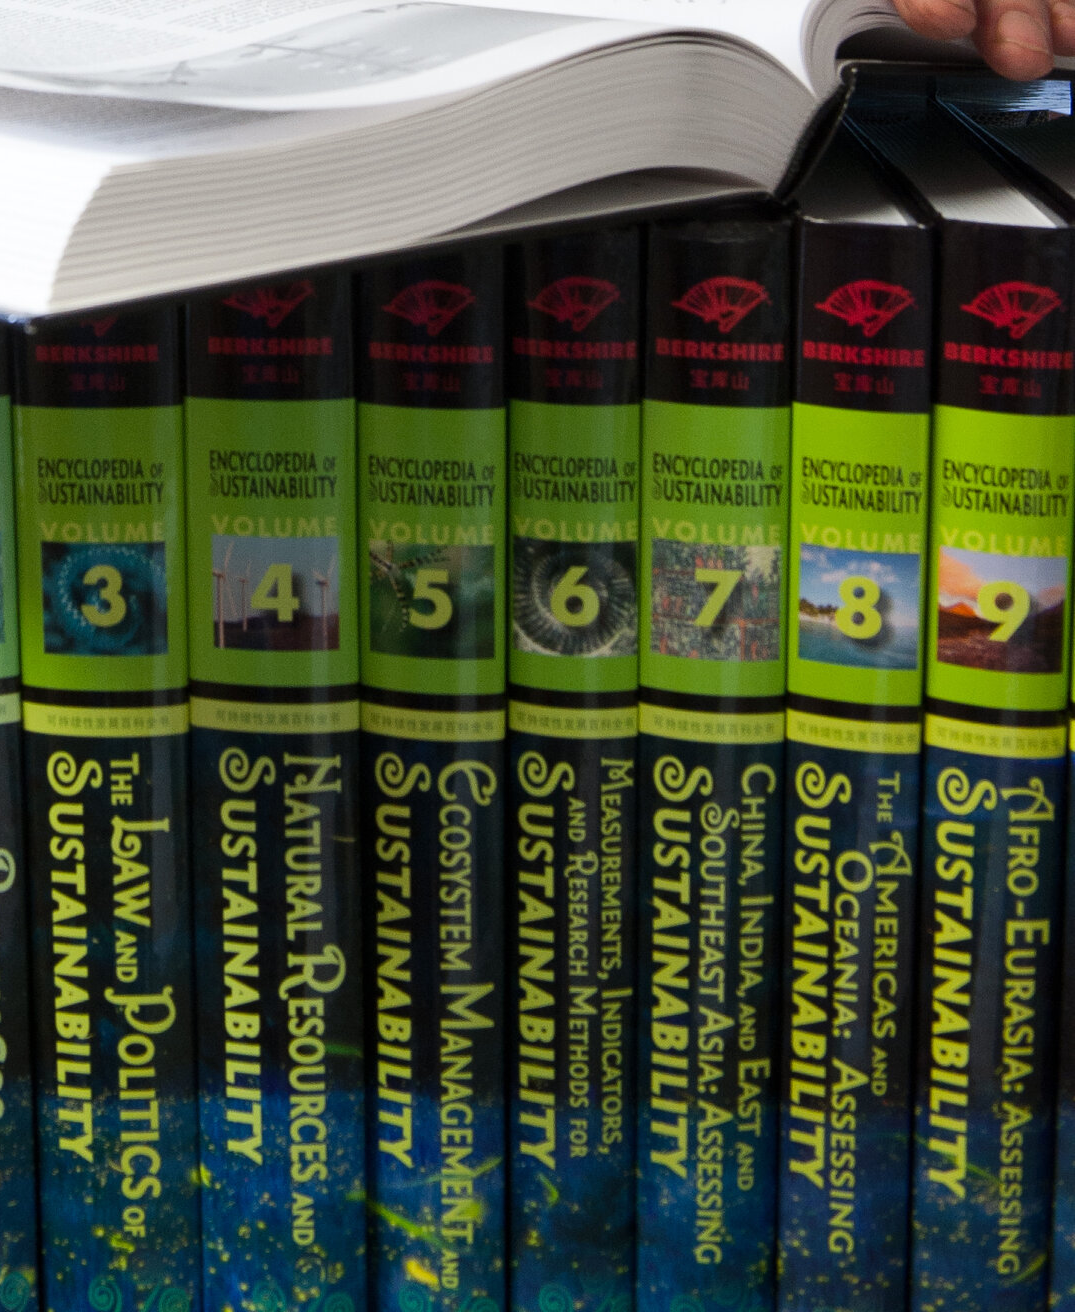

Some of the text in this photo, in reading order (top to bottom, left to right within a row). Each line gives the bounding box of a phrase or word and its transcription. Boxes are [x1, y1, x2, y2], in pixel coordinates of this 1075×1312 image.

[35, 343, 160, 364] BERKSHIRE
[207, 334, 333, 358] BERKSHIRE
[368, 339, 494, 365] BERKSHIRE
[512, 336, 638, 361] BERKSHIRE
[655, 336, 786, 362] BERKSHIRE
[802, 340, 925, 368] BERKSHIRE
[943, 341, 1074, 371] BERKSHIRE
[36, 456, 146, 481] ENCYCLOPEDIA
[208, 449, 319, 474] ENCYCLOPEDIA
[367, 454, 477, 483] ENCYCLOPEDIA
[512, 450, 622, 479] ENCYCLOPEDIA
[651, 450, 766, 482] ENCYCLOPEDIA
[800, 455, 905, 486] ENCYCLOPEDIA
[941, 458, 1051, 488] ENCYCLOPEDIA
[35, 478, 165, 507] SUSTAINABILITY
[208, 471, 339, 500] SUSTAINABILITY
[367, 478, 497, 509] SUSTAINABILITY
[512, 477, 637, 507] SUSTAINABILITY
[651, 480, 783, 508] SUSTAINABILITY
[799, 486, 923, 515] SUSTAINABILITY
[940, 487, 1070, 518] SUSTAINABILITY
[39, 520, 165, 544] VOLUME
[210, 514, 338, 540] VOLUME
[368, 517, 495, 546] VOLUME
[514, 516, 639, 544] VOLUME
[651, 516, 783, 546] VOLUME
[799, 522, 923, 553] VOLUME
[938, 523, 1067, 557] VOLUME
[80, 564, 128, 630] 3
[250, 561, 300, 623] 4
[408, 567, 454, 632] 5
[549, 564, 601, 628] 6
[693, 567, 746, 629] 7
[834, 574, 883, 639] 8
[975, 580, 1031, 643] 9
[868, 772, 913, 1097] THE AMERICAS AND
[46, 750, 104, 1165] SUSTAINABILITY
[218, 746, 277, 1167] SUSTAINABILITY
[374, 750, 432, 1170] SUSTAINABILITY
[517, 750, 576, 1171] SUSTAINABILITY
[599, 757, 635, 1156] MEASUREMENTS, INDICATORS,
[648, 755, 715, 1179] SUSTAINABILITY
[564, 796, 599, 1159] AND RESEARCH METHODS FOR
[734, 763, 777, 1191] CHINA, INDIA, AND EAST AND
[787, 761, 853, 1190] SUSTAINABILITY
[927, 766, 998, 1199] SUSTAINABILITY
[104, 752, 177, 1240] THE LAW AND POLITICS OF
[279, 753, 348, 1248] NATURAL RESOURCES AND
[437, 758, 499, 1290] ECOSYSTEM MANAGEMENT AND
[694, 802, 741, 1267] SOUTHEAST ASIA: ASSESSING
[996, 776, 1056, 1276] AFRO-EURASIA: ASSESSING
[827, 850, 876, 1256] OCEANIA: ASSESSING
